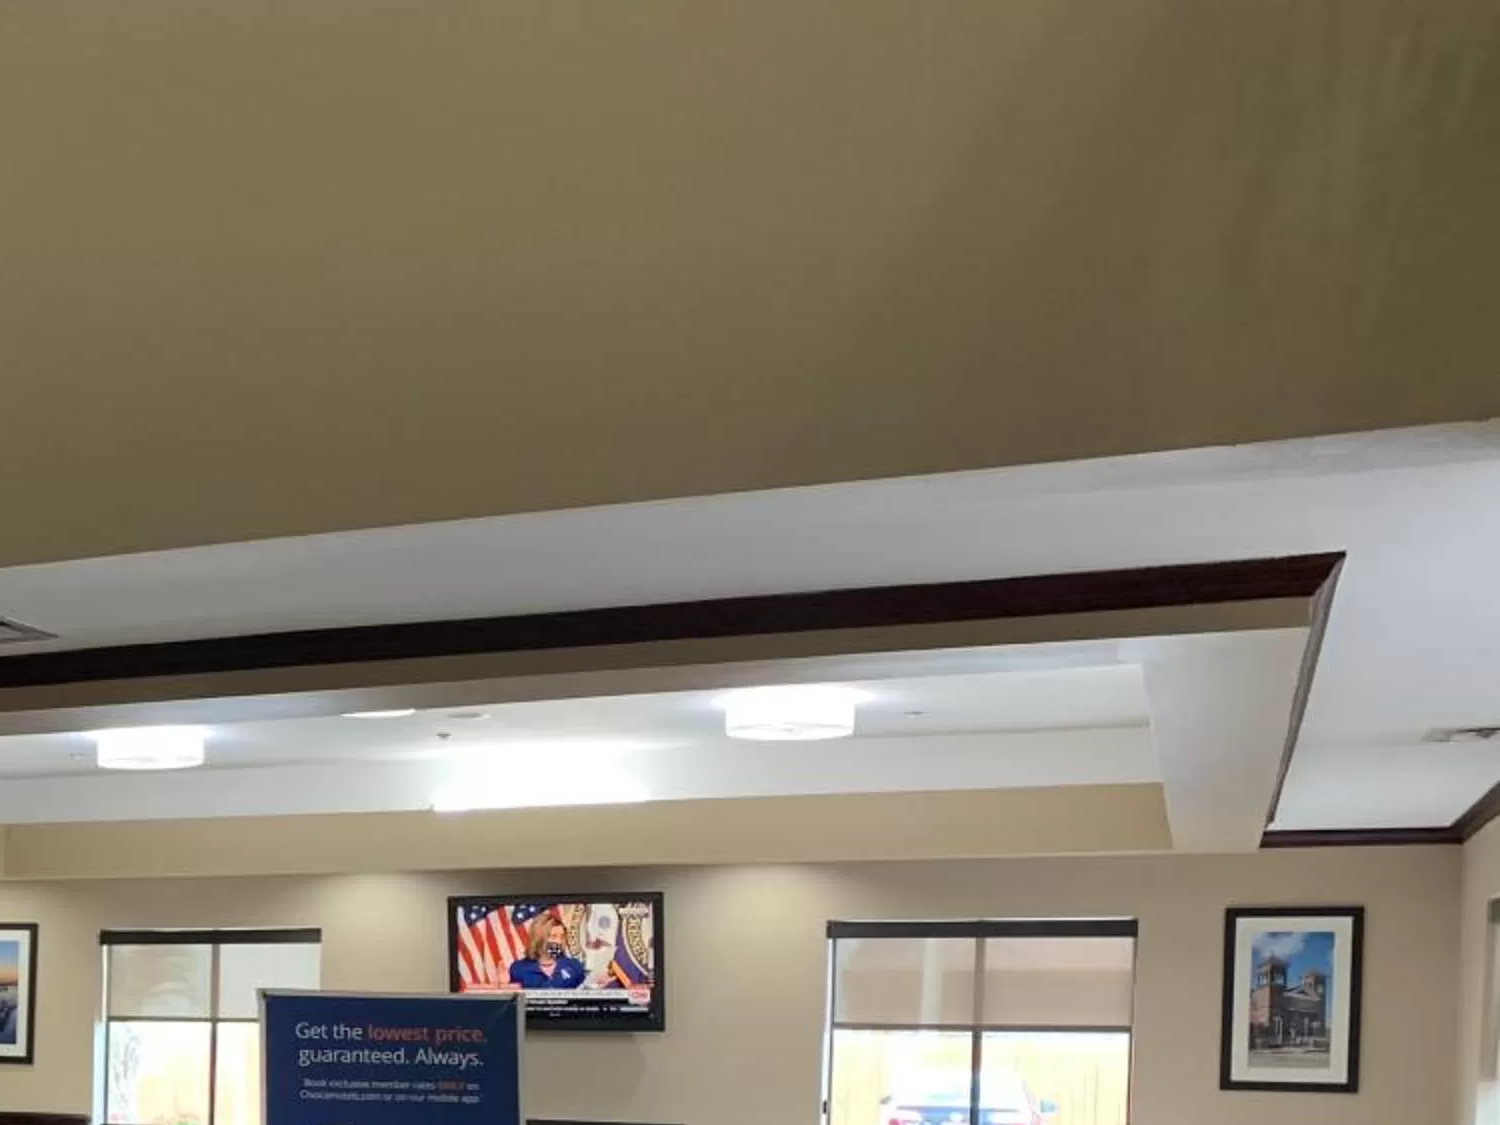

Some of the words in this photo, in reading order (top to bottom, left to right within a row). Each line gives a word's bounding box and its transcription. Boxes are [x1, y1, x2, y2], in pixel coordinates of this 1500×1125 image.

[295, 1021, 328, 1040] Get
[333, 1023, 363, 1040] the
[367, 1024, 429, 1041] lowest
[298, 1047, 410, 1066] guaranteed.
[414, 1047, 485, 1070] Always.
